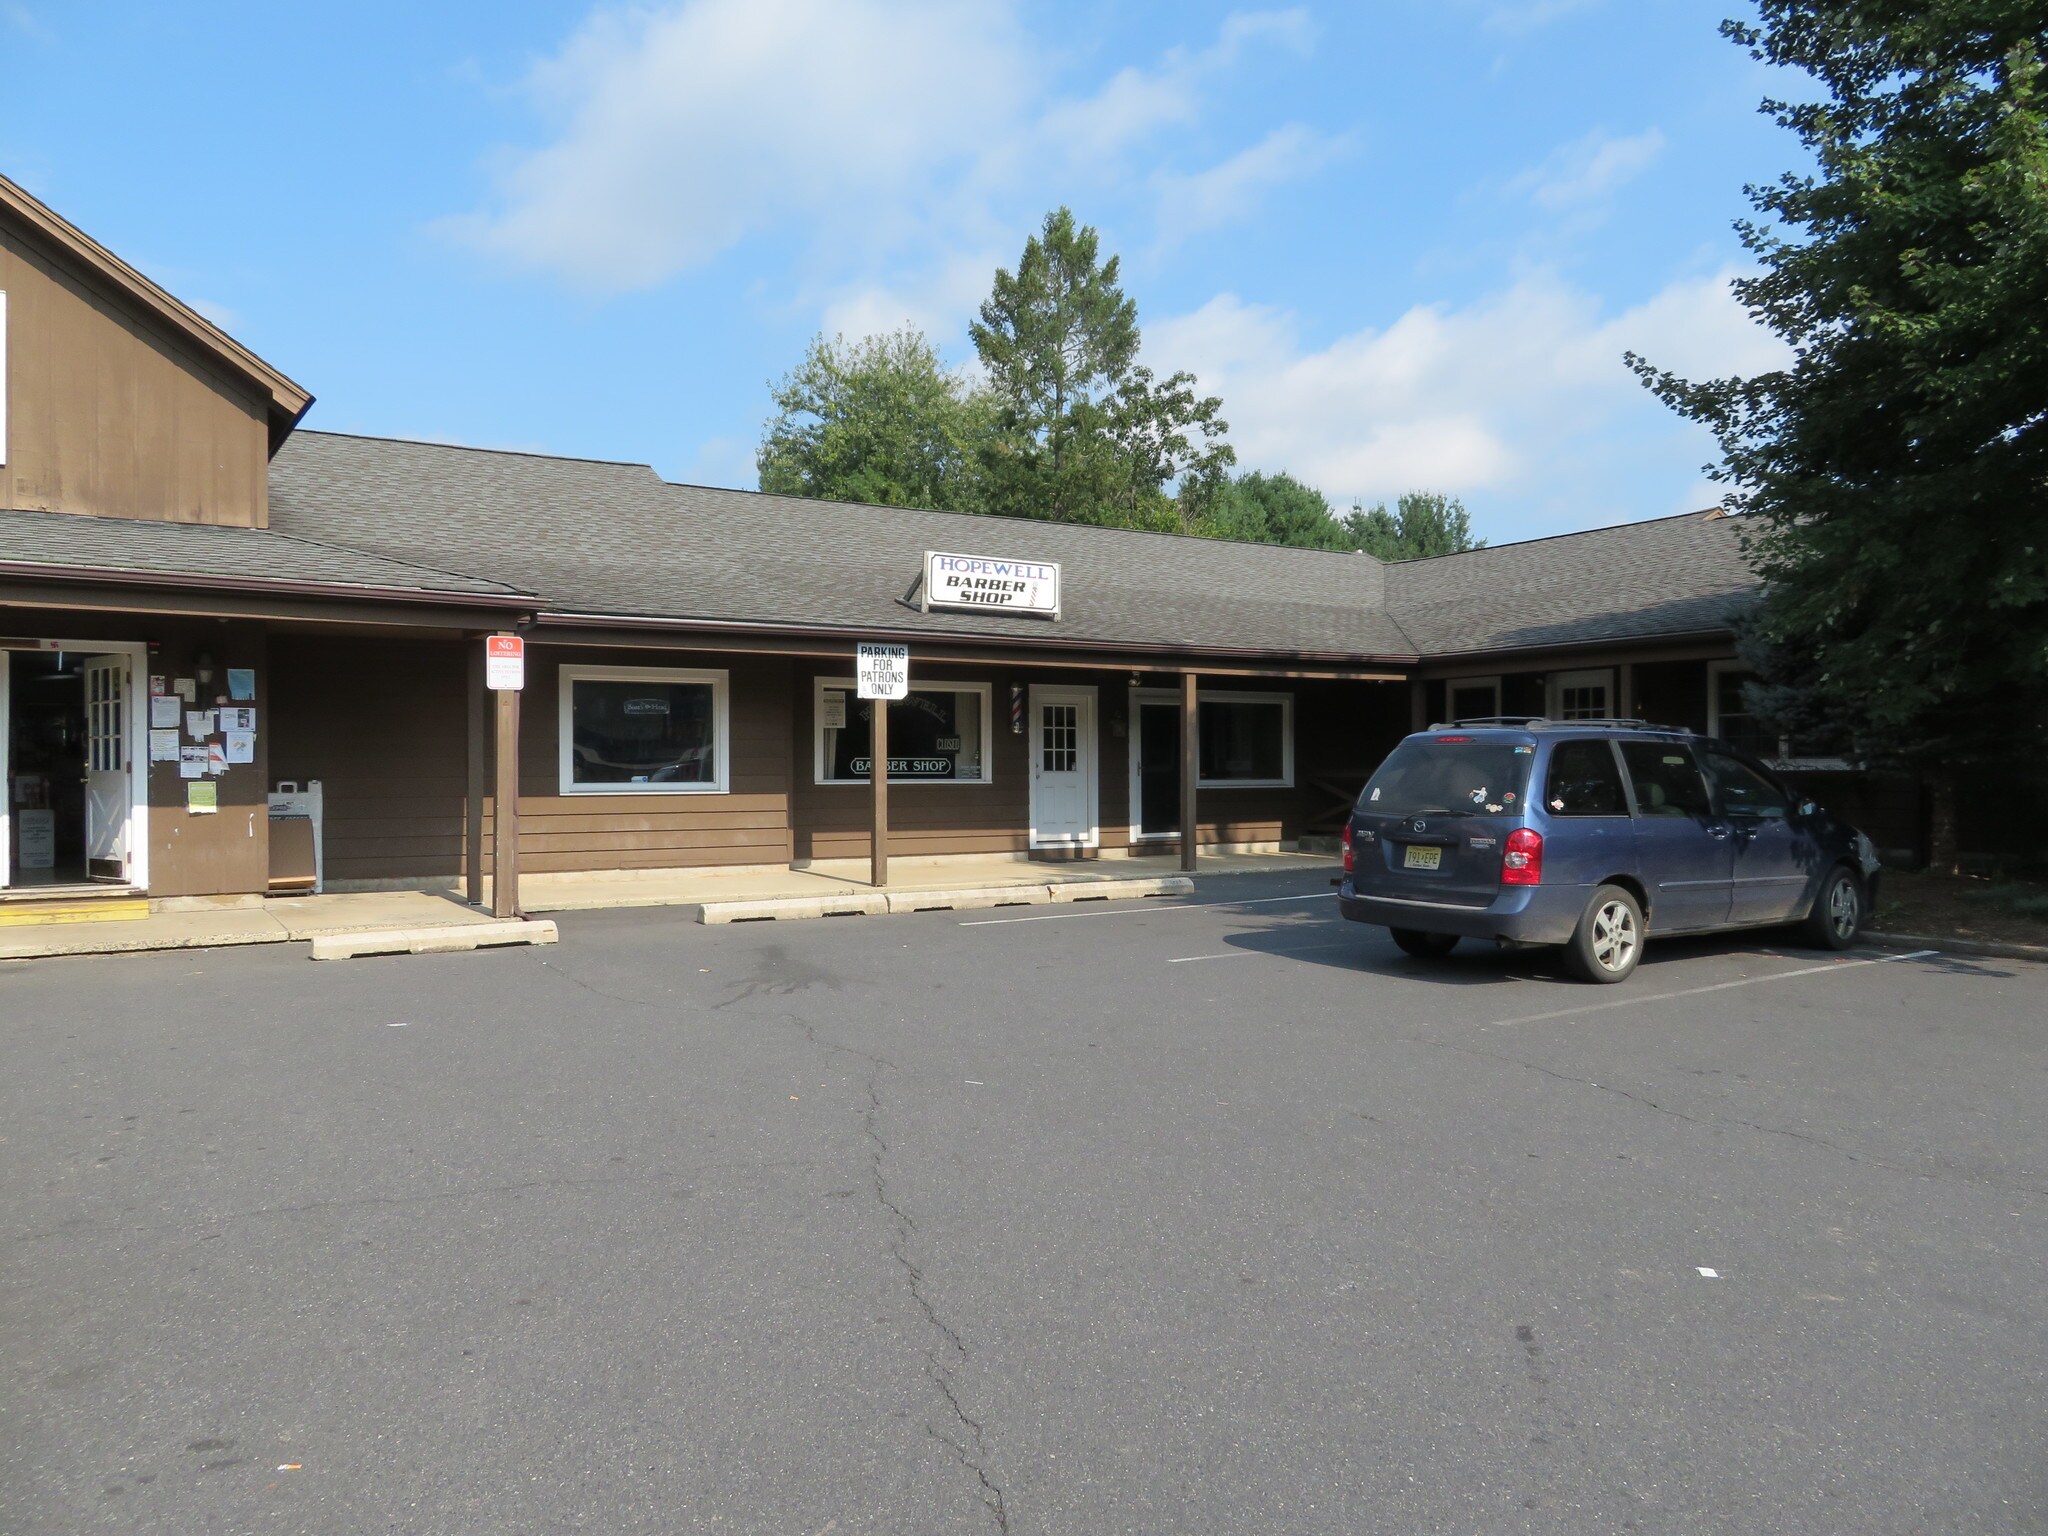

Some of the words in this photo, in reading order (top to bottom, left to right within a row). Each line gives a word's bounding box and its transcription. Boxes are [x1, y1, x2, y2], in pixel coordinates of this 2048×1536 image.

[940, 558, 1048, 580] HOPEWELL
[946, 576, 1026, 592] BARBER
[960, 590, 1013, 604] SHOP
[498, 641, 513, 650] NO
[861, 646, 905, 659] PARKING
[873, 659, 893, 671] FOR
[861, 671, 904, 683] PATRONS
[871, 683, 894, 695] ONLY
[913, 760, 947, 771] SHOP
